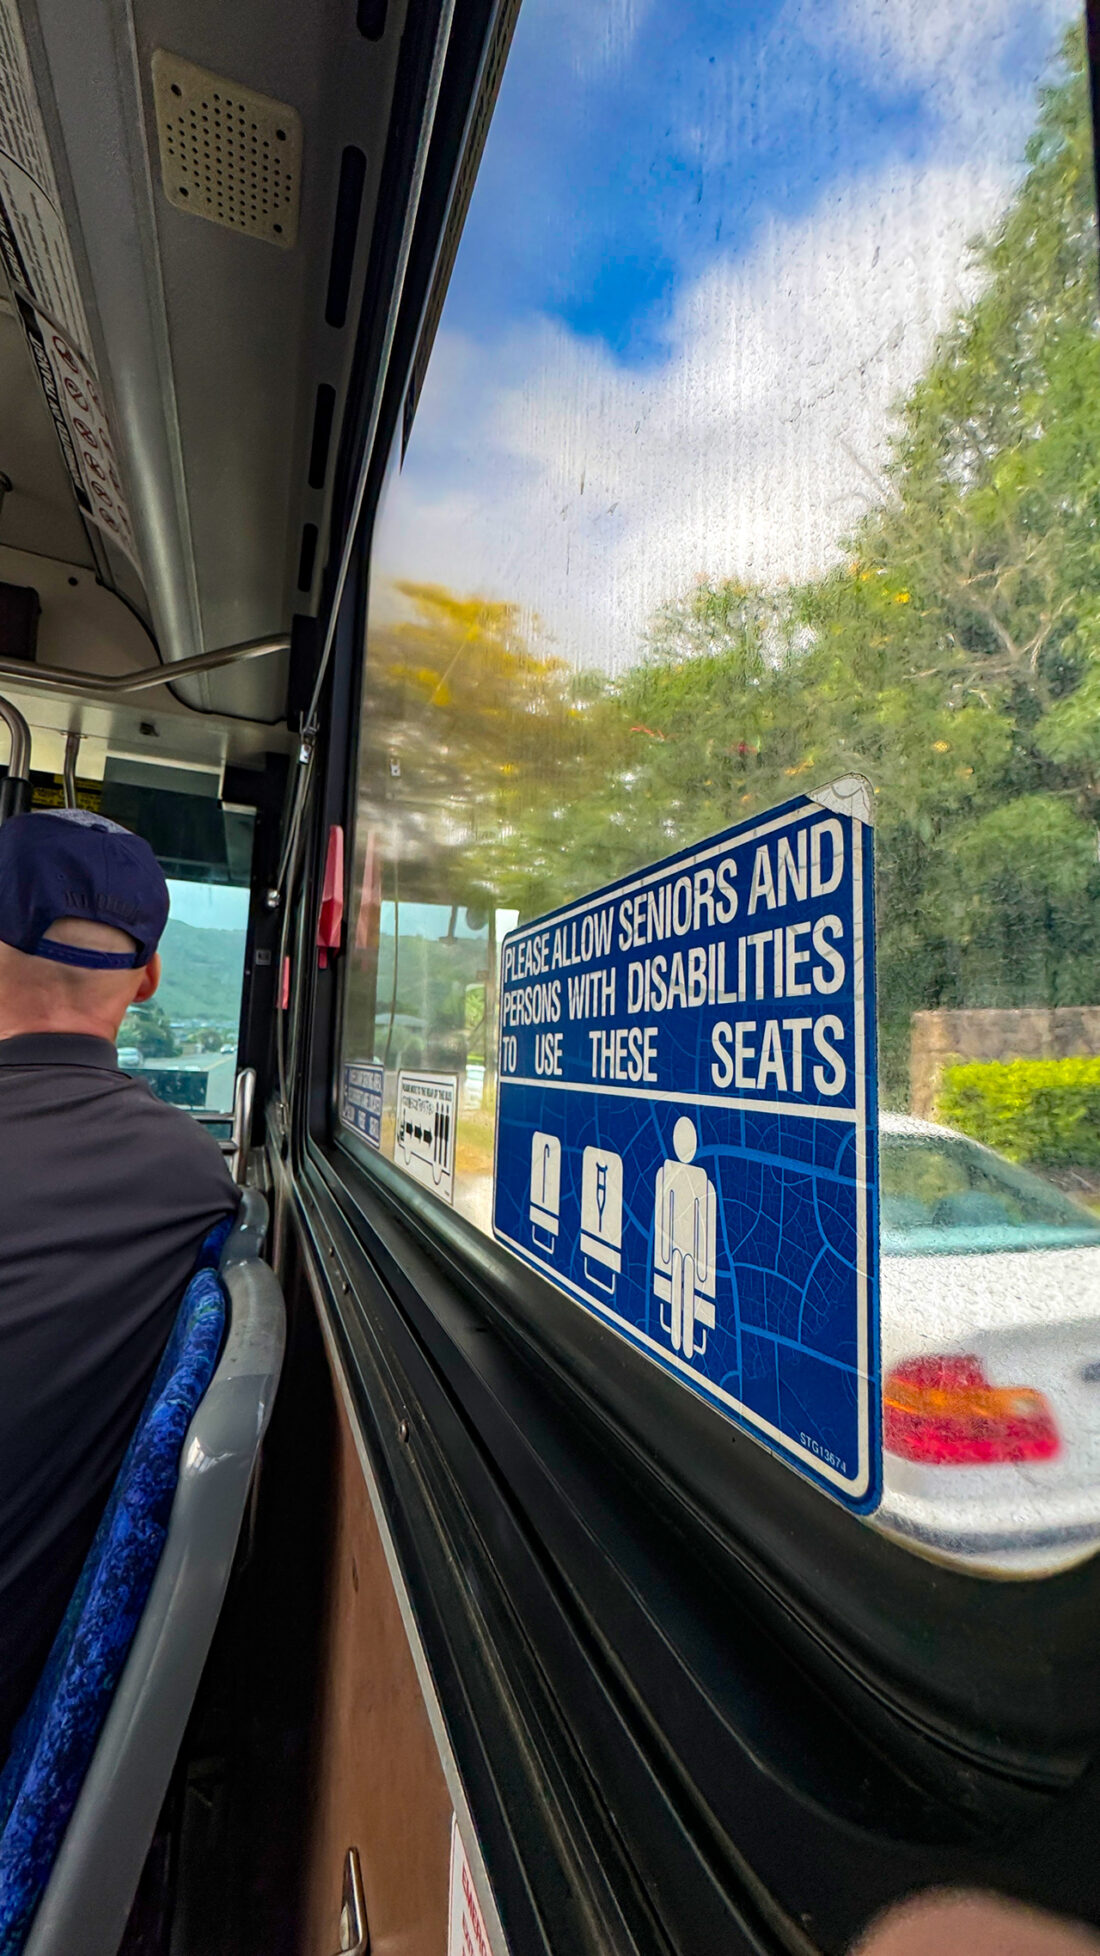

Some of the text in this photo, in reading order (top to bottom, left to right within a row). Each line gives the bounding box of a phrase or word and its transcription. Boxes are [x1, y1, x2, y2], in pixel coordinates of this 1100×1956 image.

[504, 817, 845, 984] PLEASE ALLOW SENIORS AND
[503, 914, 846, 1028] PERSONS WITH DISABILITIES
[502, 1013, 847, 1097] TO USE THESE SEATS
